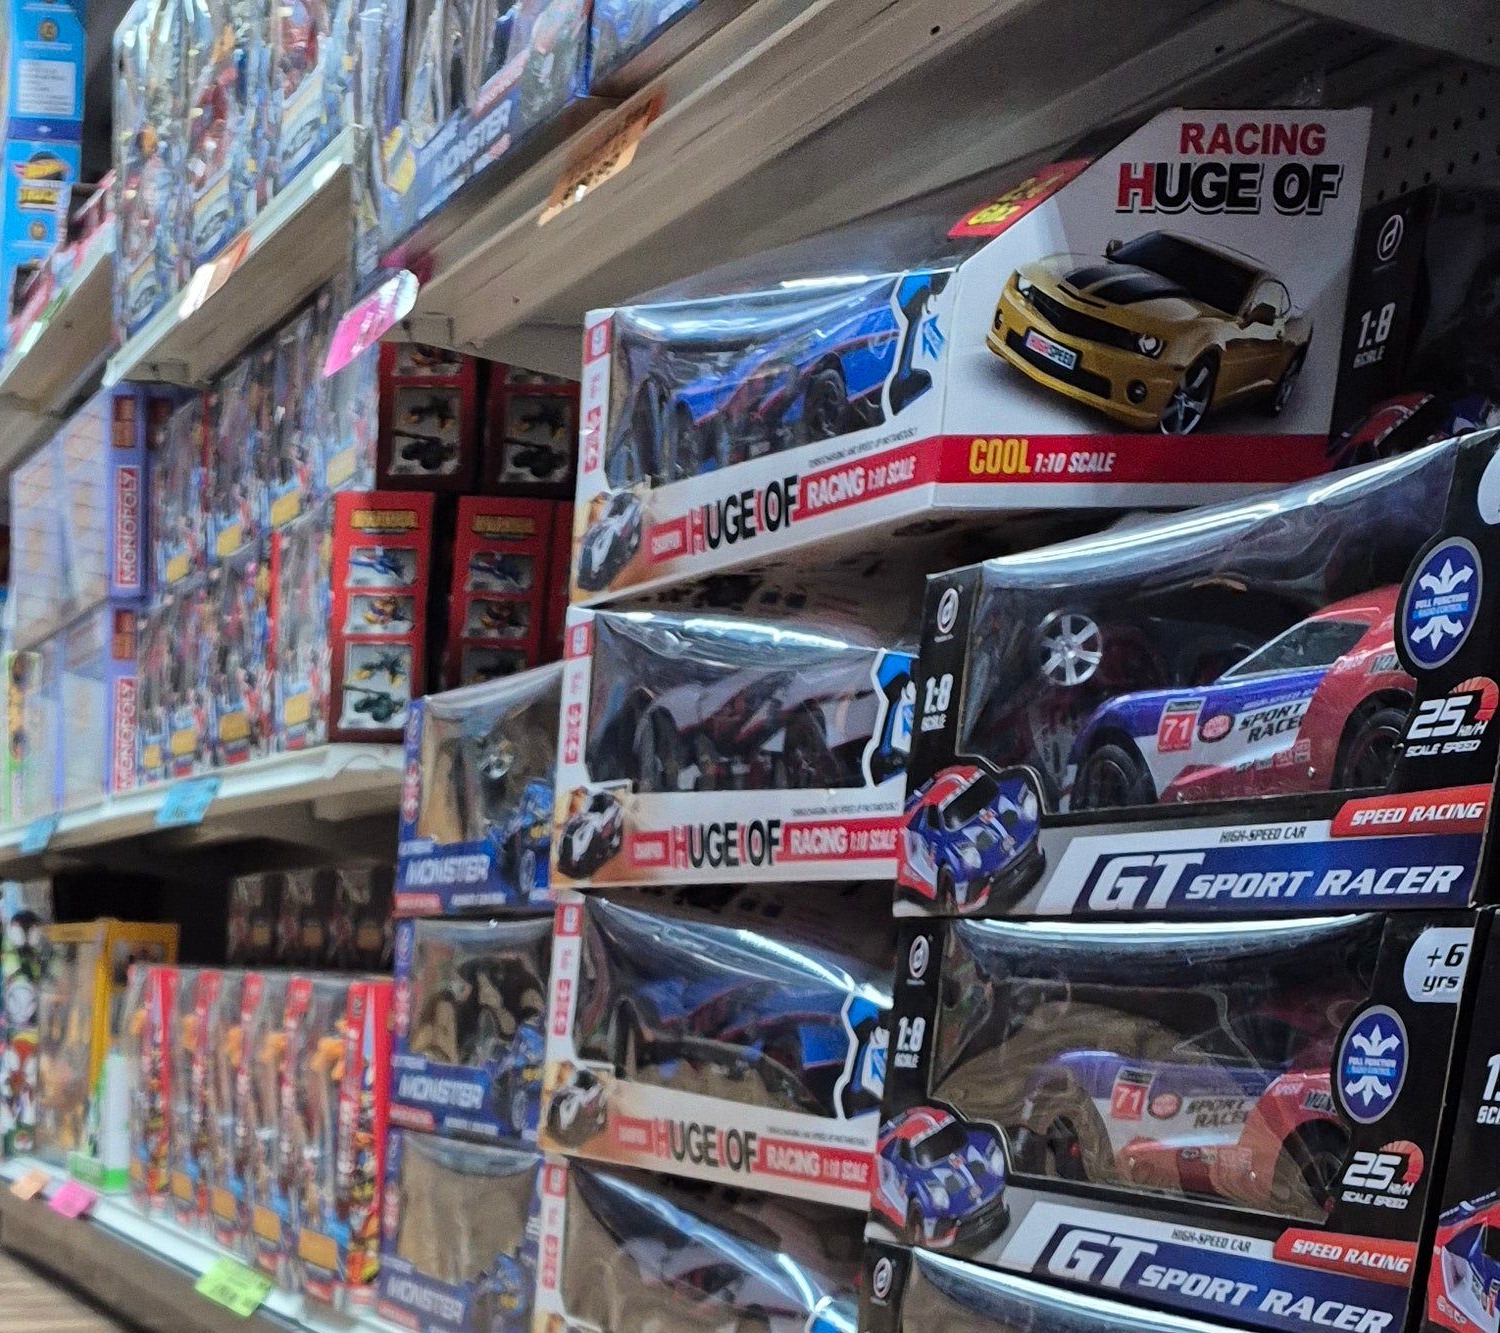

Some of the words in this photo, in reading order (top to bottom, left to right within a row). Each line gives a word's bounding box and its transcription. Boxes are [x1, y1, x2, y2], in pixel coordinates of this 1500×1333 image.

[1180, 123, 1326, 156] RACING
[1116, 161, 1266, 214] HUGE
[1271, 162, 1344, 215] OF
[1357, 302, 1396, 350] 1:8
[969, 438, 1031, 474] COOL
[1033, 454, 1065, 474] 1:10
[1067, 452, 1116, 474] SCALE
[688, 490, 757, 556] HUGE
[763, 475, 800, 533] OF
[807, 469, 866, 510] RACING
[886, 455, 917, 486] SCALE
[122, 468, 139, 588] MONOPOLY
[924, 673, 953, 714] 1:8
[1164, 717, 1190, 742] 71
[1238, 703, 1303, 731] SPORT
[1406, 694, 1473, 739] 25
[117, 680, 137, 790] MONOPOLY
[1404, 742, 1442, 758] SCALE
[1441, 739, 1481, 754] SPEED
[1351, 806, 1406, 826] SPEED
[1408, 802, 1485, 822] RACING
[671, 822, 739, 869] HUGE
[748, 819, 781, 868] OF
[790, 828, 848, 857] RACING
[1219, 828, 1281, 844] HIGH-SPEED
[1283, 826, 1307, 840] CAR
[405, 854, 491, 887] MONSTER
[1088, 851, 1206, 911] GT
[1185, 870, 1313, 899] SPORT
[1315, 865, 1464, 897] RACER
[1427, 942, 1468, 968] +6
[1422, 974, 1460, 993] yrs
[896, 1016, 926, 1052] 1:8
[399, 1072, 484, 1111] MONSTER
[1116, 1086, 1144, 1112] 71
[655, 1117, 719, 1168] HUGE
[725, 1128, 757, 1173] OF
[766, 1145, 820, 1176] RACING
[1342, 1151, 1402, 1190] 25
[1341, 1190, 1375, 1205] SCALE
[1373, 1194, 1409, 1211] SPEED
[1171, 1228, 1229, 1250] HIGH-SPEED
[1230, 1237, 1252, 1253] CAR
[1291, 1238, 1343, 1262] SPEED
[1344, 1248, 1412, 1274] RACING
[1047, 1228, 1158, 1290] GT
[1138, 1264, 1259, 1307] SPORT
[386, 1275, 465, 1325] MONSTER
